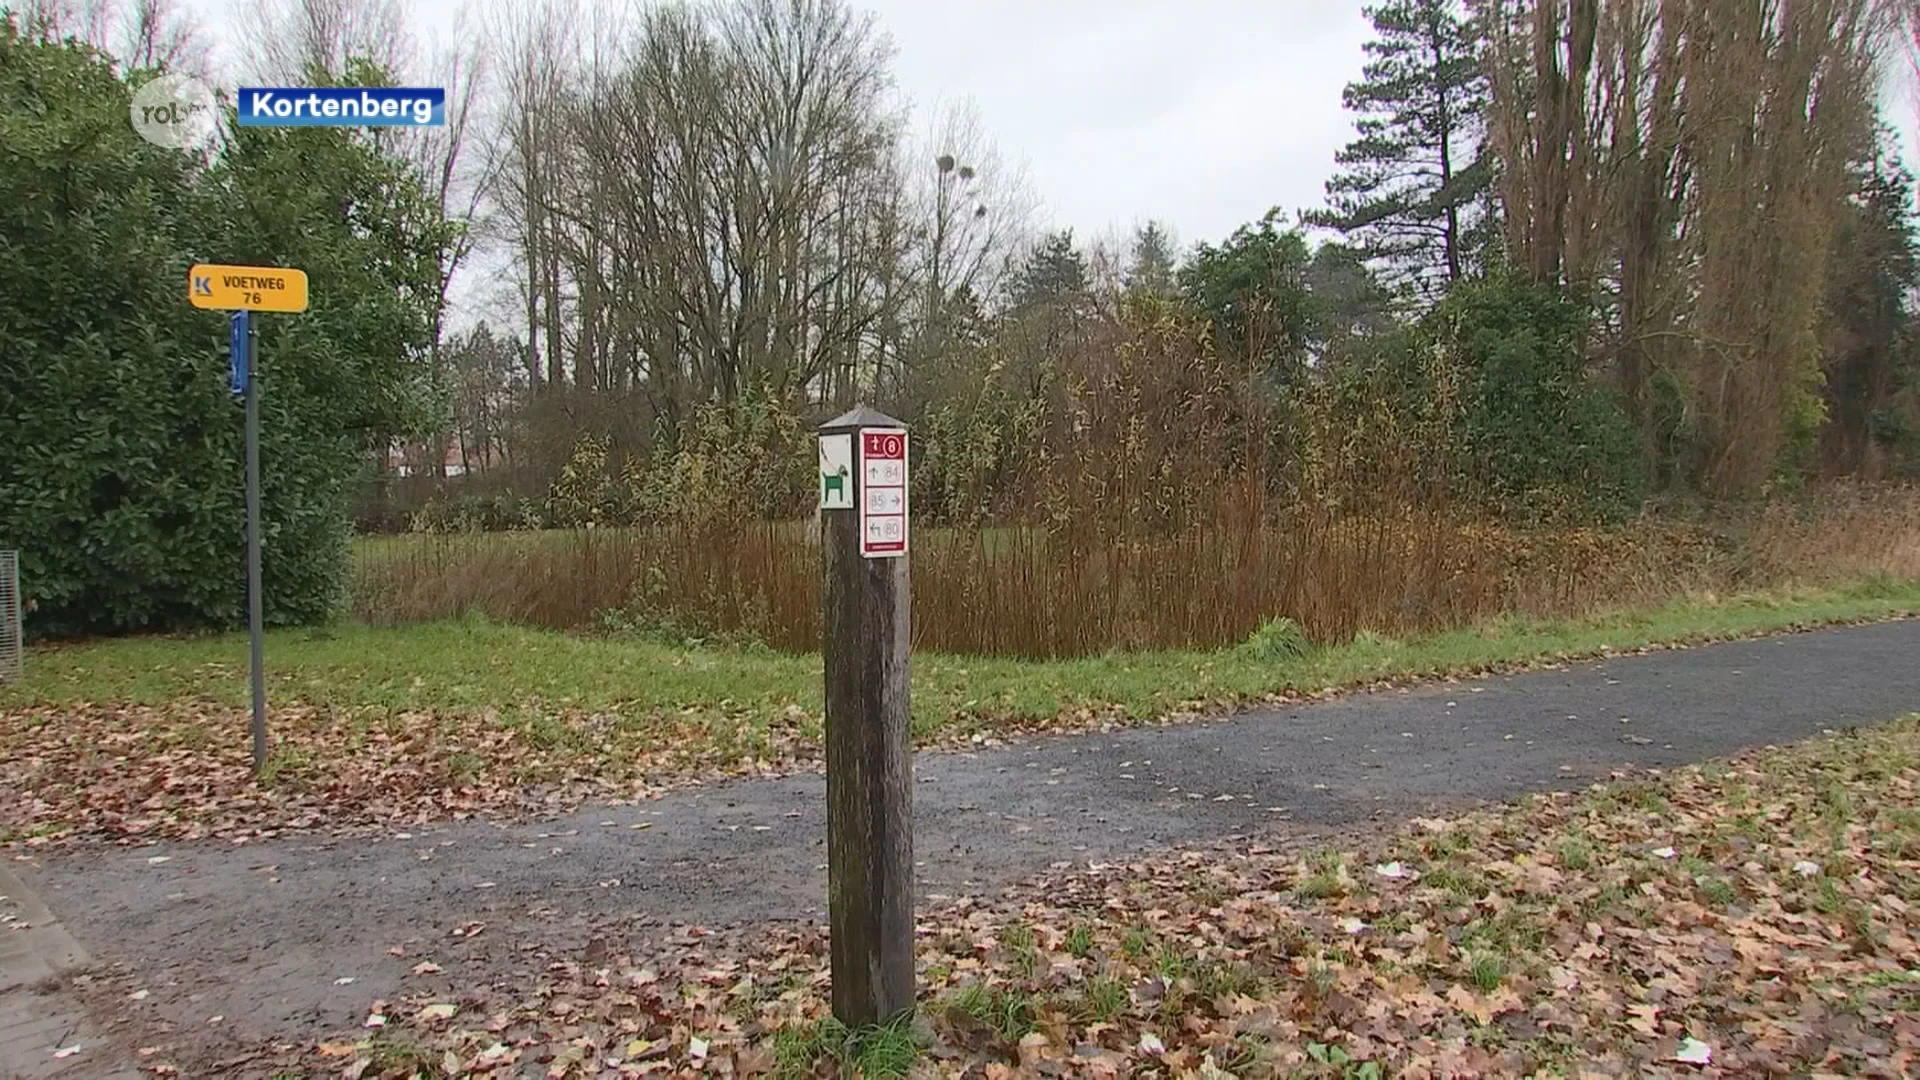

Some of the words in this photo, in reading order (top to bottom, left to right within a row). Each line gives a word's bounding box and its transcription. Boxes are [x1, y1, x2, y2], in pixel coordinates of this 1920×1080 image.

[223, 276, 285, 290] VOETWEG
[244, 292, 262, 304] 76
[888, 440, 896, 453] 8
[885, 467, 898, 478] 84
[887, 523, 898, 534] 80
